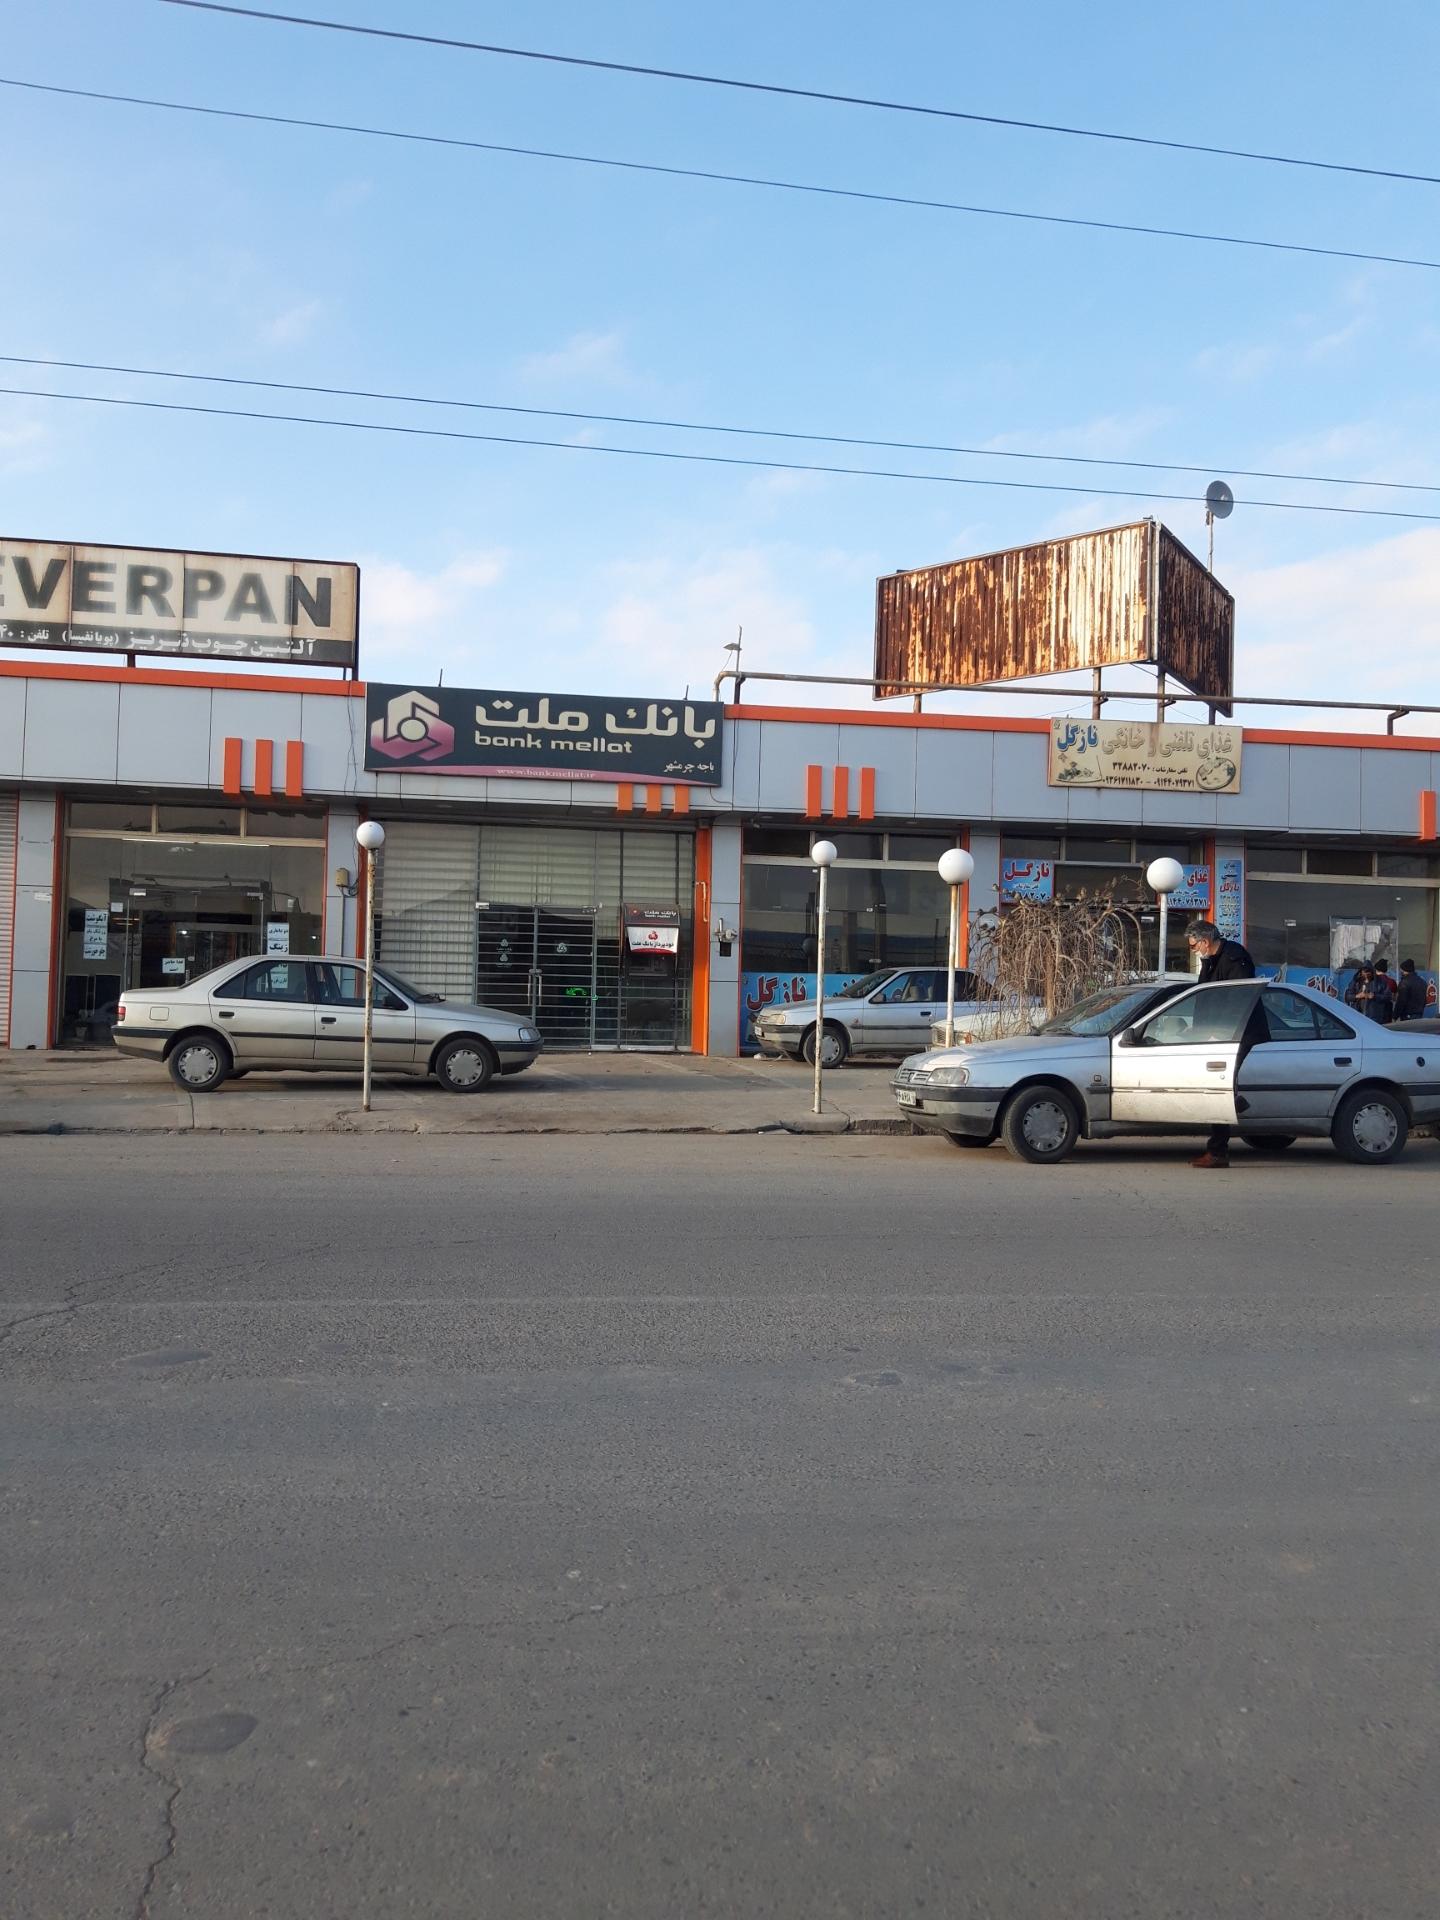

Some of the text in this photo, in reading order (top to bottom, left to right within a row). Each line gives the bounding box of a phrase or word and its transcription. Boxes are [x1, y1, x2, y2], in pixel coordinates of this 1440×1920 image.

[0, 554, 332, 628] VERPAN
[192, 637, 248, 656] چوب
[475, 698, 589, 732] ملت
[474, 730, 633, 754] bank mellat
[1101, 727, 1146, 755] خانگی
[1159, 728, 1195, 758] تلفنی
[1197, 731, 1233, 758] غذای
[495, 767, 596, 779] www.bankmellat.ir
[697, 761, 715, 772] باجه
[1187, 868, 1208, 888] غذای
